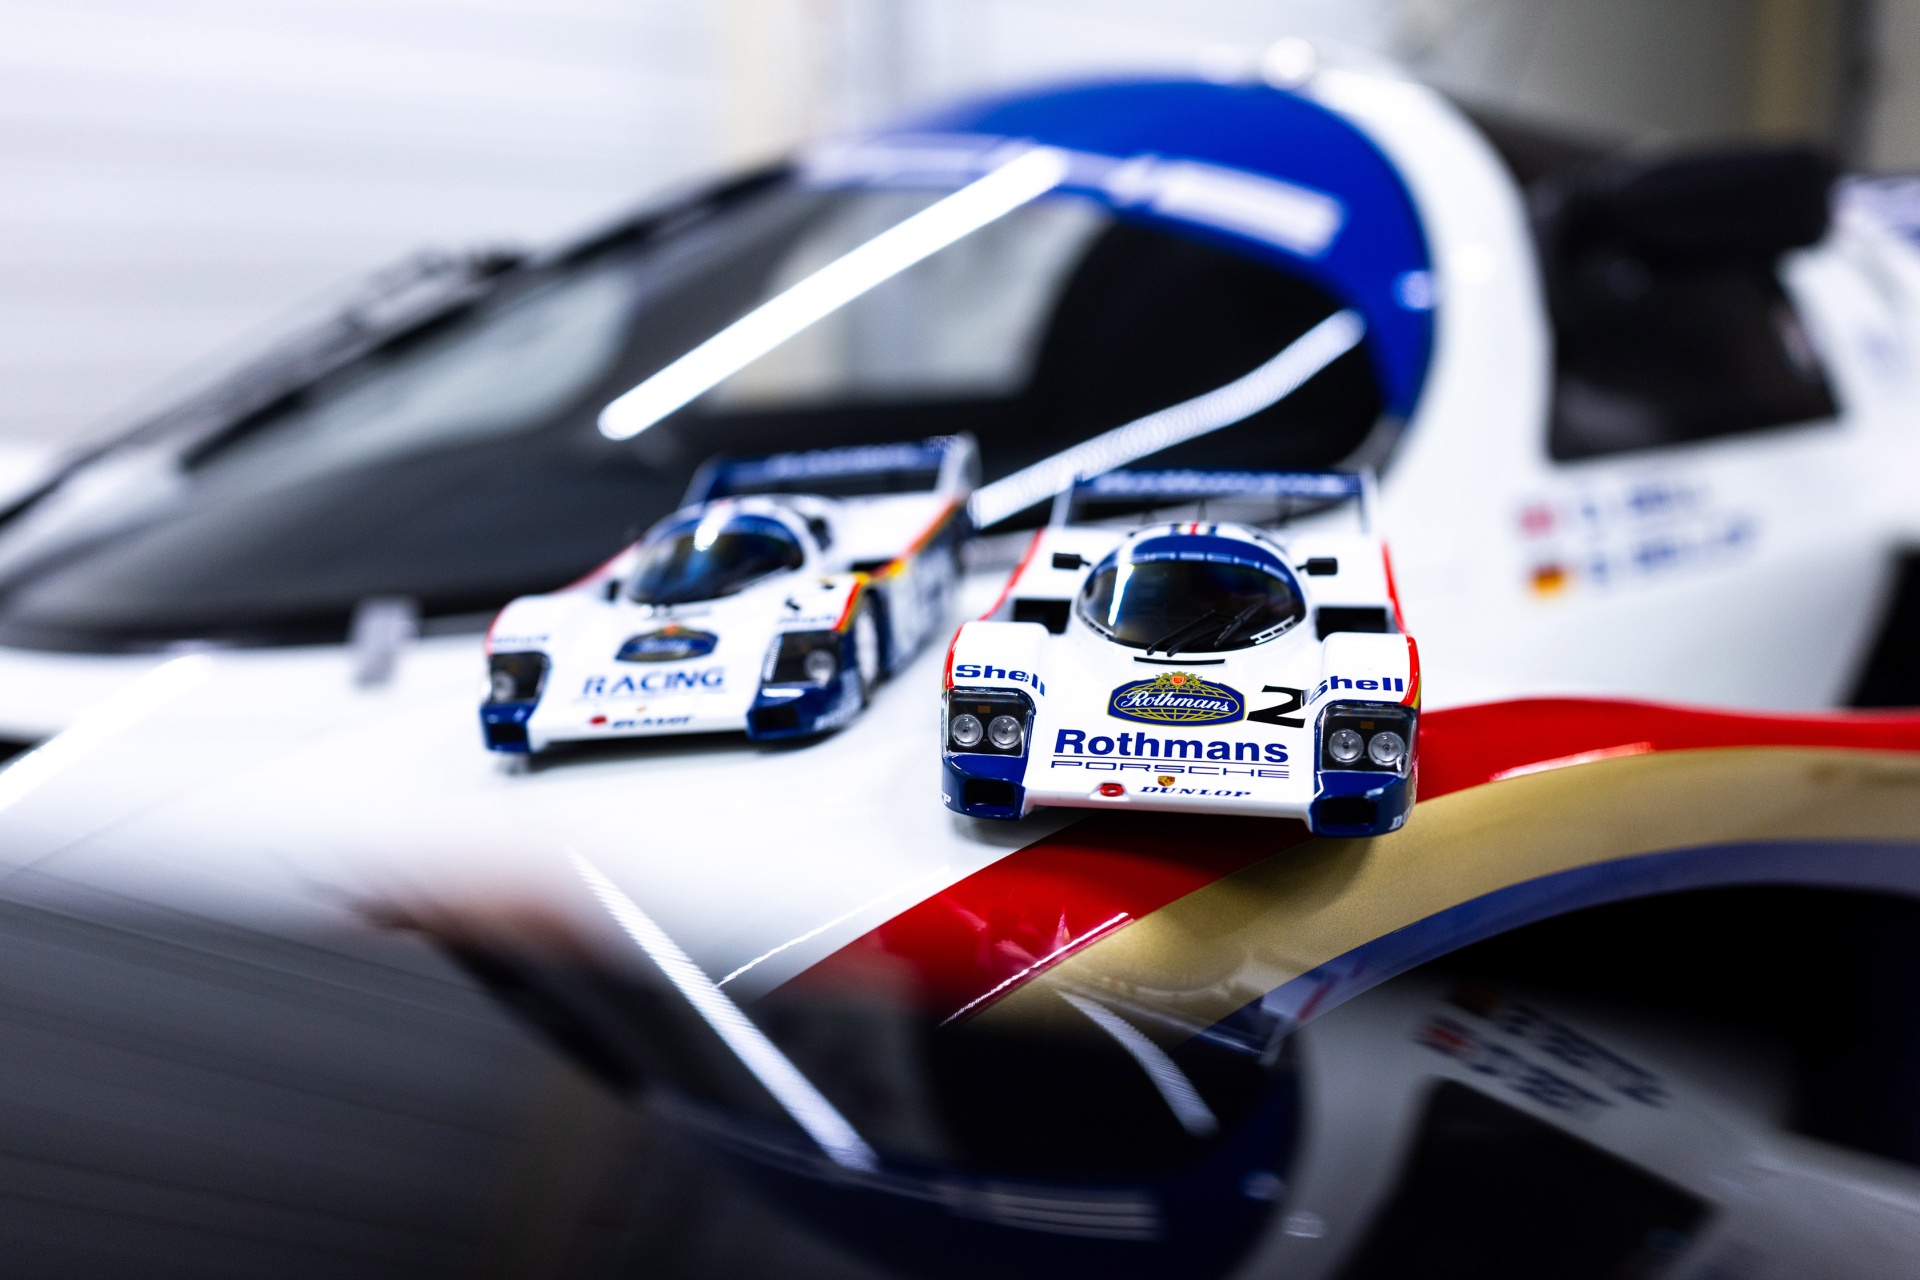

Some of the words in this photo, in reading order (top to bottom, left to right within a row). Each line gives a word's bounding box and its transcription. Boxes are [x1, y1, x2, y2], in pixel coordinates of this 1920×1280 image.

[583, 667, 725, 695] RACING
[955, 664, 1045, 697] Shell
[1309, 675, 1403, 705] Shell
[1120, 689, 1230, 712] Rothmans
[1246, 685, 1307, 729] 2
[1054, 728, 1290, 763] Rothmans
[1050, 760, 1290, 779] PORSCHE
[1138, 786, 1252, 798] DUNLOP
